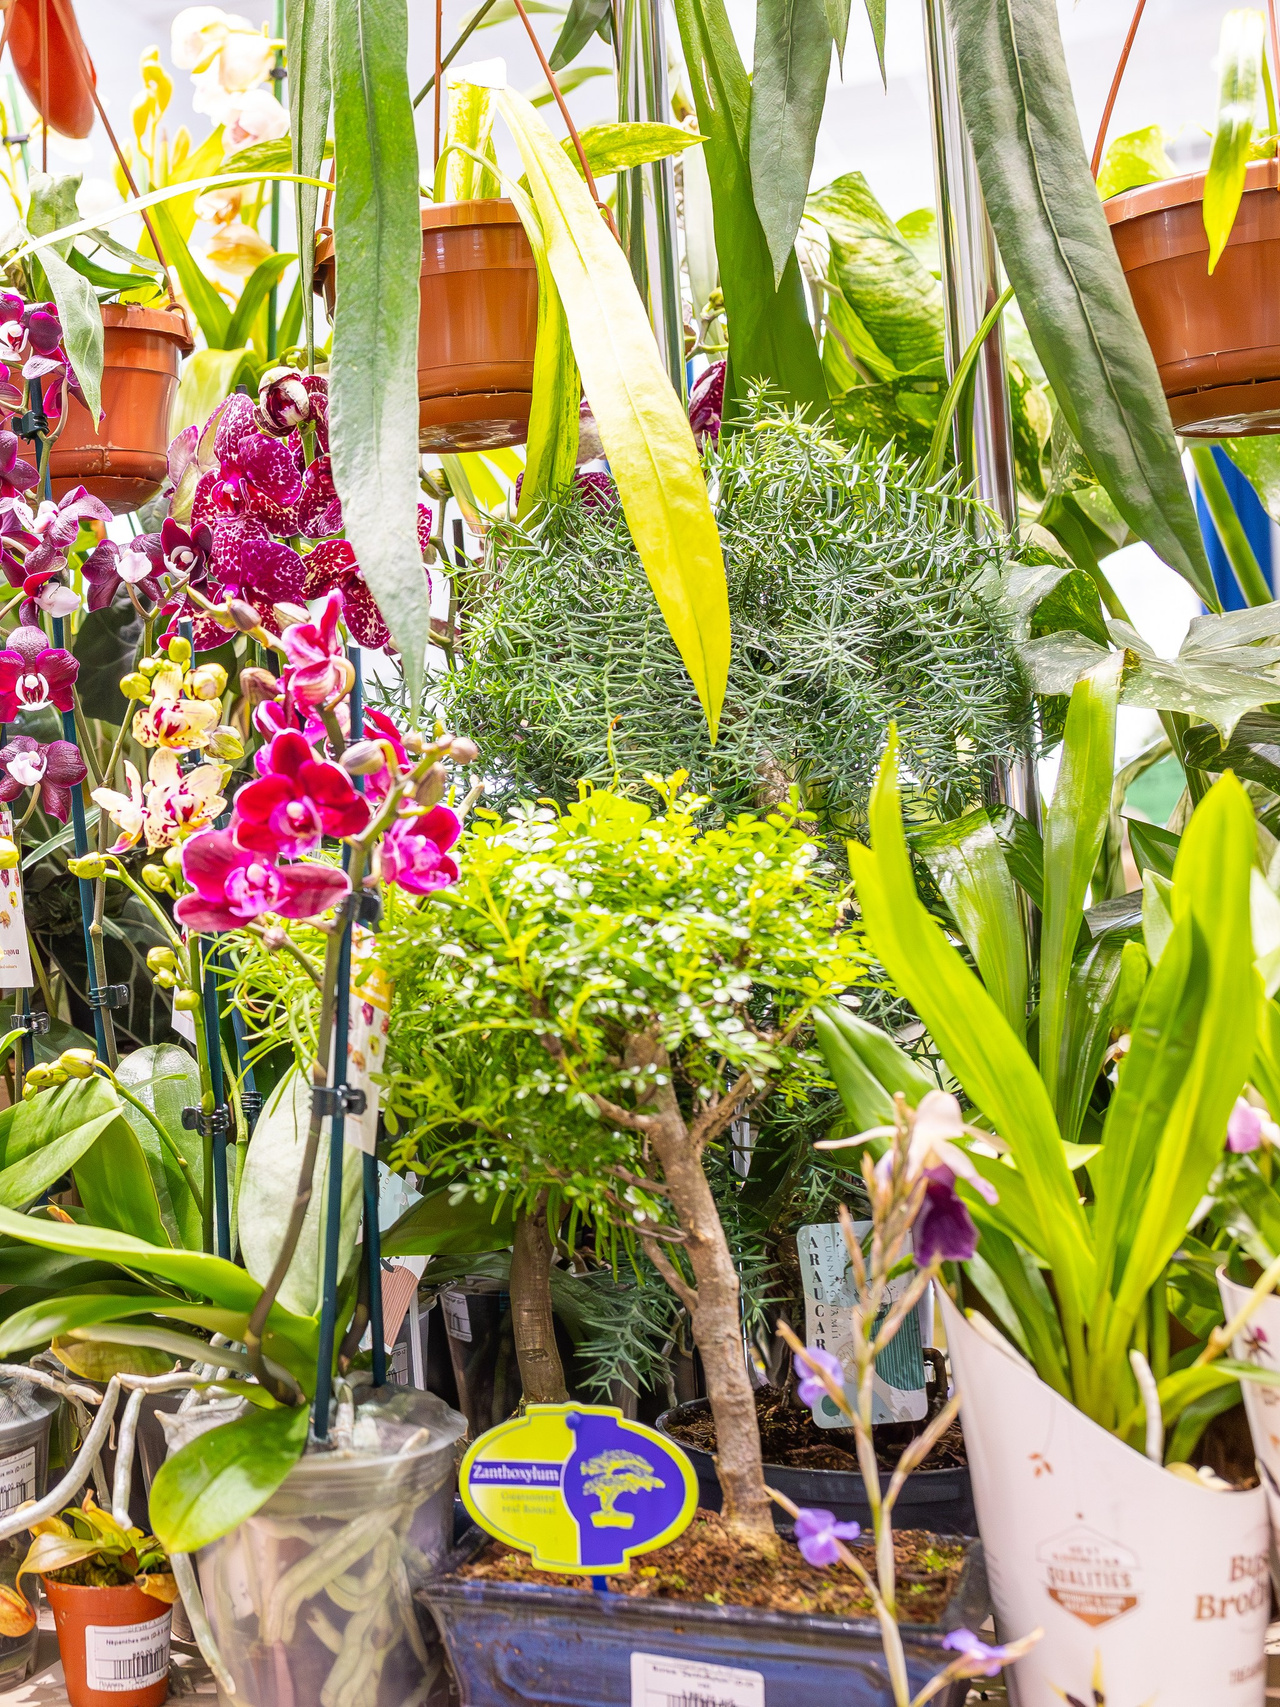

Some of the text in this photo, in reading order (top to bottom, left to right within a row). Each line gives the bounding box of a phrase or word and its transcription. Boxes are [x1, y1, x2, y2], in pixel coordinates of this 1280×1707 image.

[808, 1236, 827, 1351] ARAUCAR
[472, 1464, 560, 1484] Zanthoxylum
[1047, 1567, 1133, 1588] QUALITIES
[106, 1638, 139, 1646] Nepenthes
